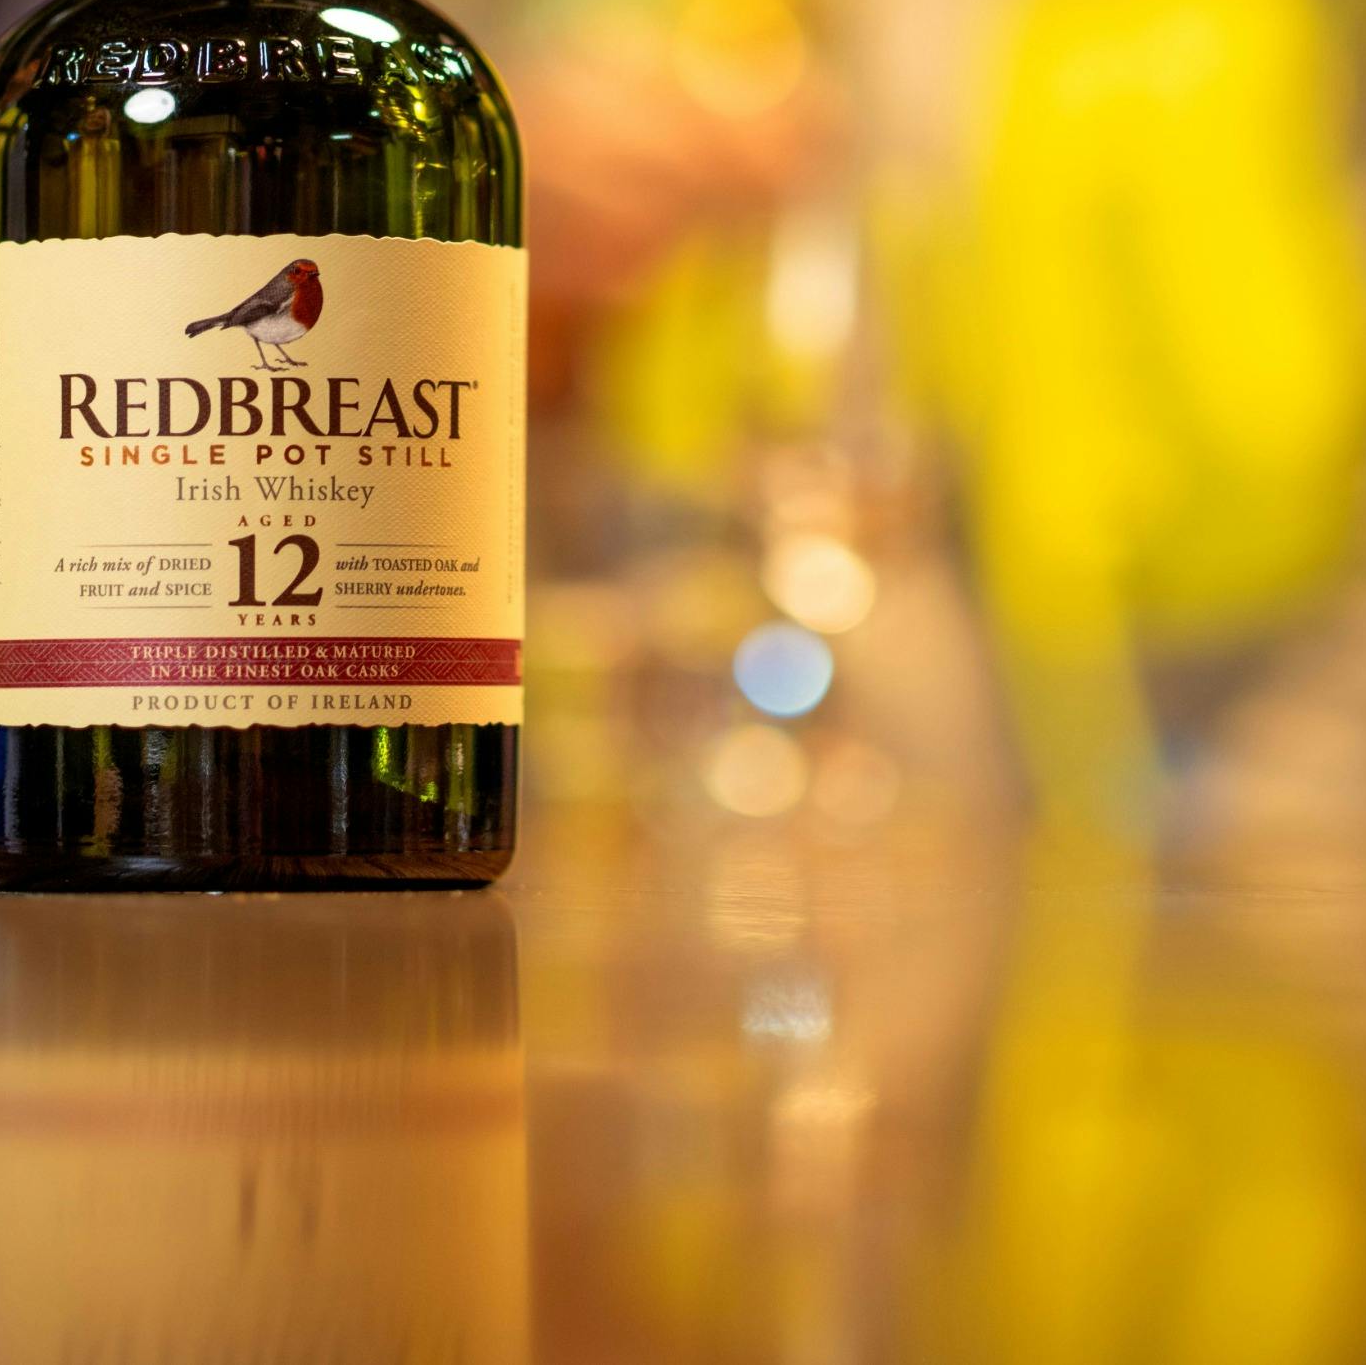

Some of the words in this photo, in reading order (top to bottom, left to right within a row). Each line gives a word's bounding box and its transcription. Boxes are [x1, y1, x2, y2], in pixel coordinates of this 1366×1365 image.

[58, 373, 471, 439] REDBREAST
[80, 444, 226, 467] SINGLE
[256, 444, 331, 466] POT
[358, 445, 452, 468] STILL
[175, 475, 242, 502] Irish
[253, 475, 375, 509] Whiskey
[237, 514, 317, 527] AGED
[54, 557, 65, 573] A
[69, 556, 98, 572] rich
[102, 557, 132, 572] mix
[136, 555, 156, 576] of
[159, 558, 212, 571] DRIED
[228, 533, 324, 607] 12
[335, 555, 369, 571] with
[372, 558, 432, 572] TOASTED
[434, 558, 459, 572] OAK
[460, 557, 481, 572] and
[79, 584, 124, 597] FRUIT
[128, 581, 161, 596] and
[165, 583, 212, 596] SPICE
[335, 582, 392, 595] SHERRY
[396, 580, 467, 596] undertones.
[238, 613, 317, 626] YEARS
[130, 645, 197, 659] TRIPLE
[206, 645, 310, 659] DISTILLED
[315, 645, 329, 659] &
[334, 645, 416, 659] MATURED
[150, 665, 170, 678] IN
[176, 664, 217, 678] THE
[225, 664, 294, 678] FINEST
[300, 664, 339, 678] OAK
[346, 664, 399, 678] CASKS
[132, 694, 254, 711] PRODUCT
[267, 693, 299, 710] OF
[311, 694, 412, 710] IRELAND
